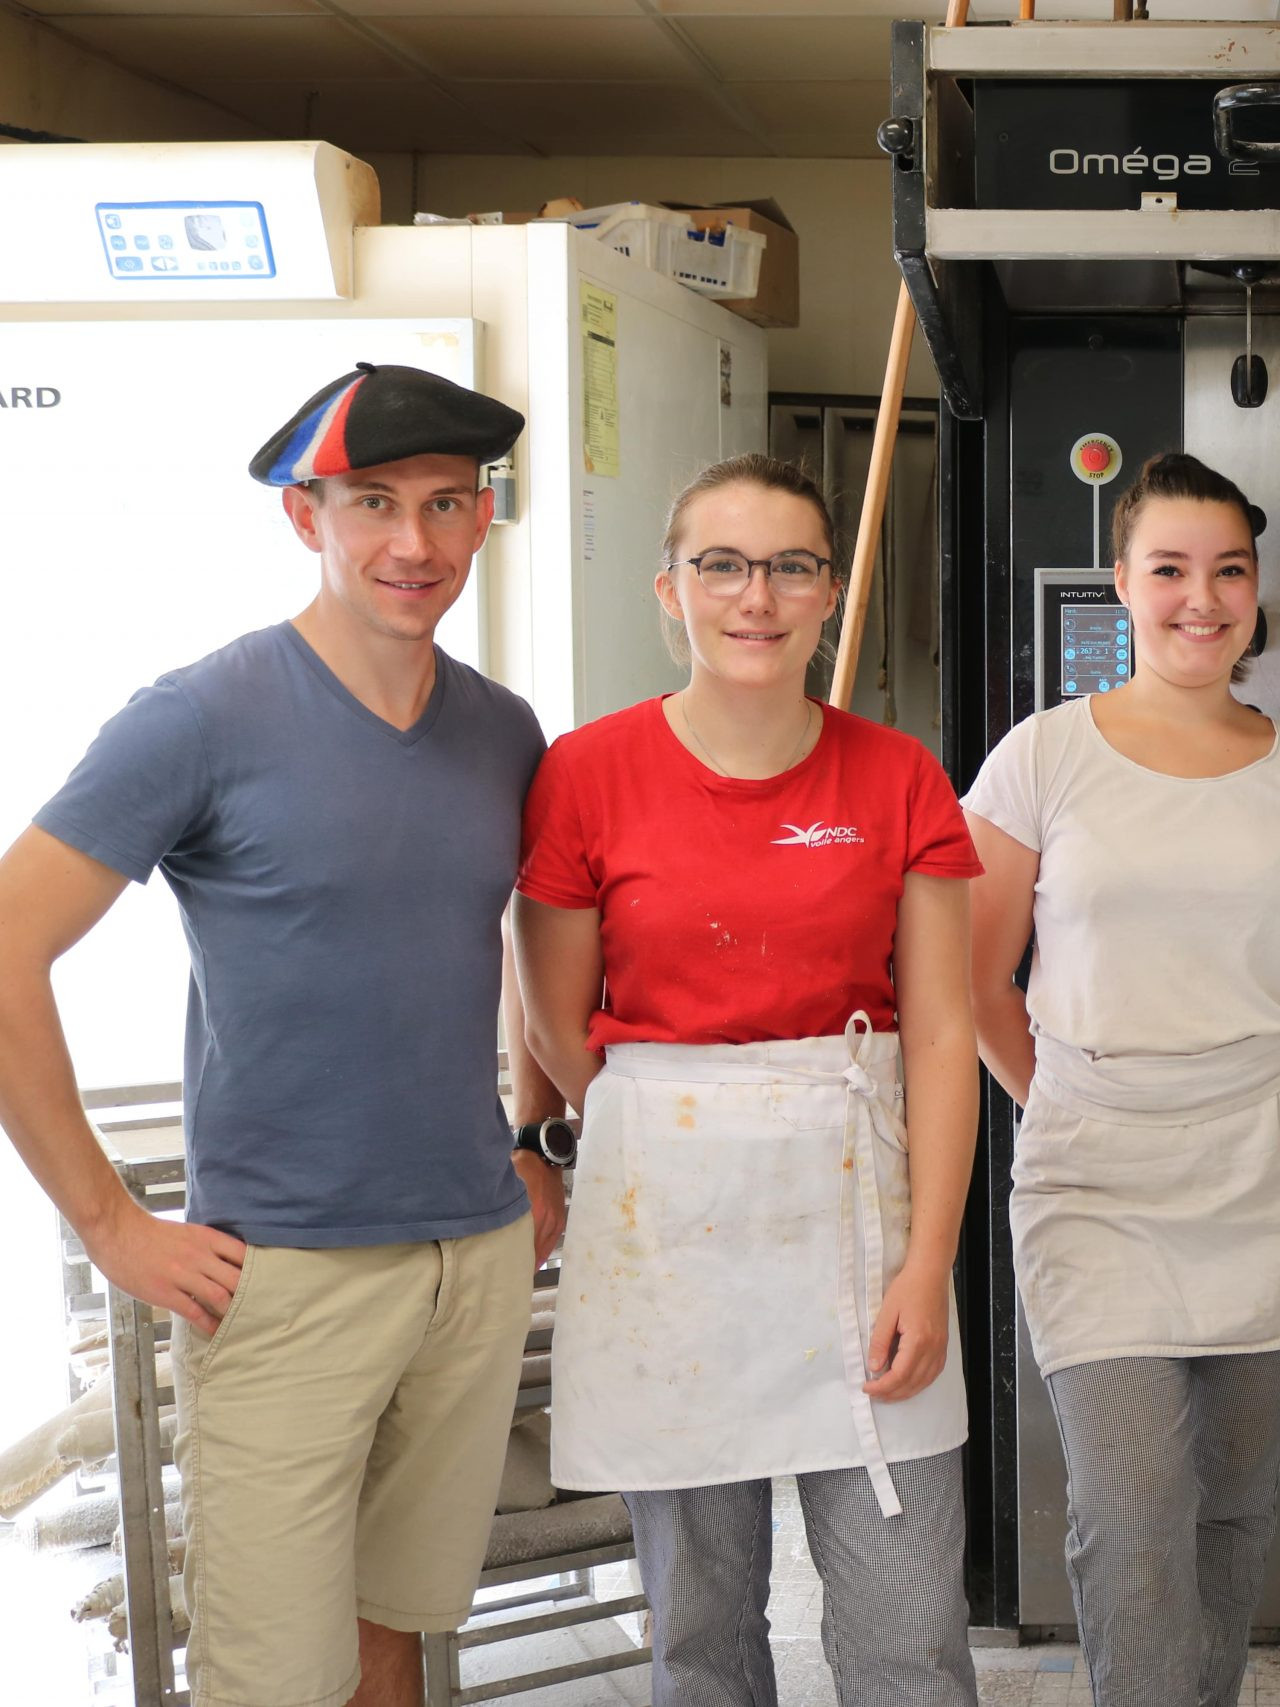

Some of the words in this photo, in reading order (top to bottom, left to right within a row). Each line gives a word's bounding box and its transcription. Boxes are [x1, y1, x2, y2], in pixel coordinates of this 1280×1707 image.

[1050, 146, 1211, 180] Oméga
[826, 826, 857, 838] NDC
[834, 836, 865, 844] angers
